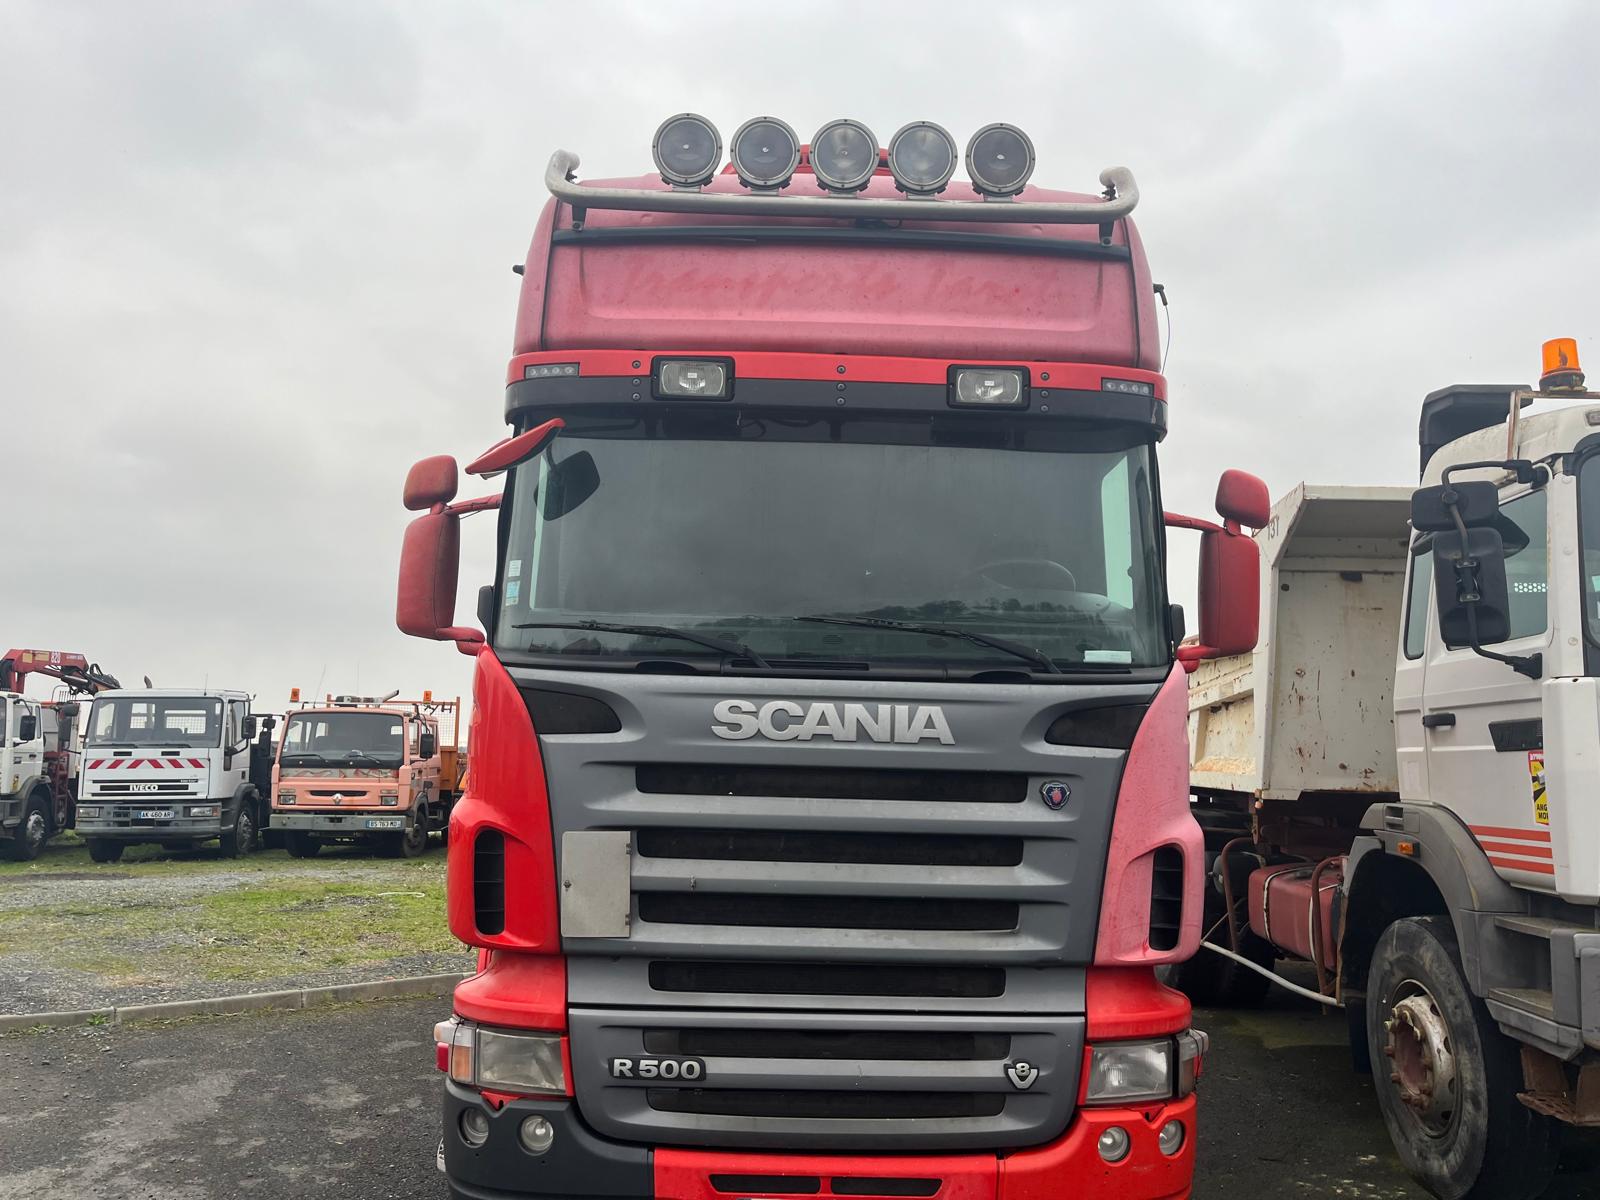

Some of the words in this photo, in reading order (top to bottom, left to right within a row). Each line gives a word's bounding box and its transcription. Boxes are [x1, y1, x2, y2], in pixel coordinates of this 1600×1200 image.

[711, 699, 956, 745] SCANIA
[129, 784, 159, 792] IVECO
[613, 1058, 634, 1078] R
[639, 1059, 701, 1080] 500
